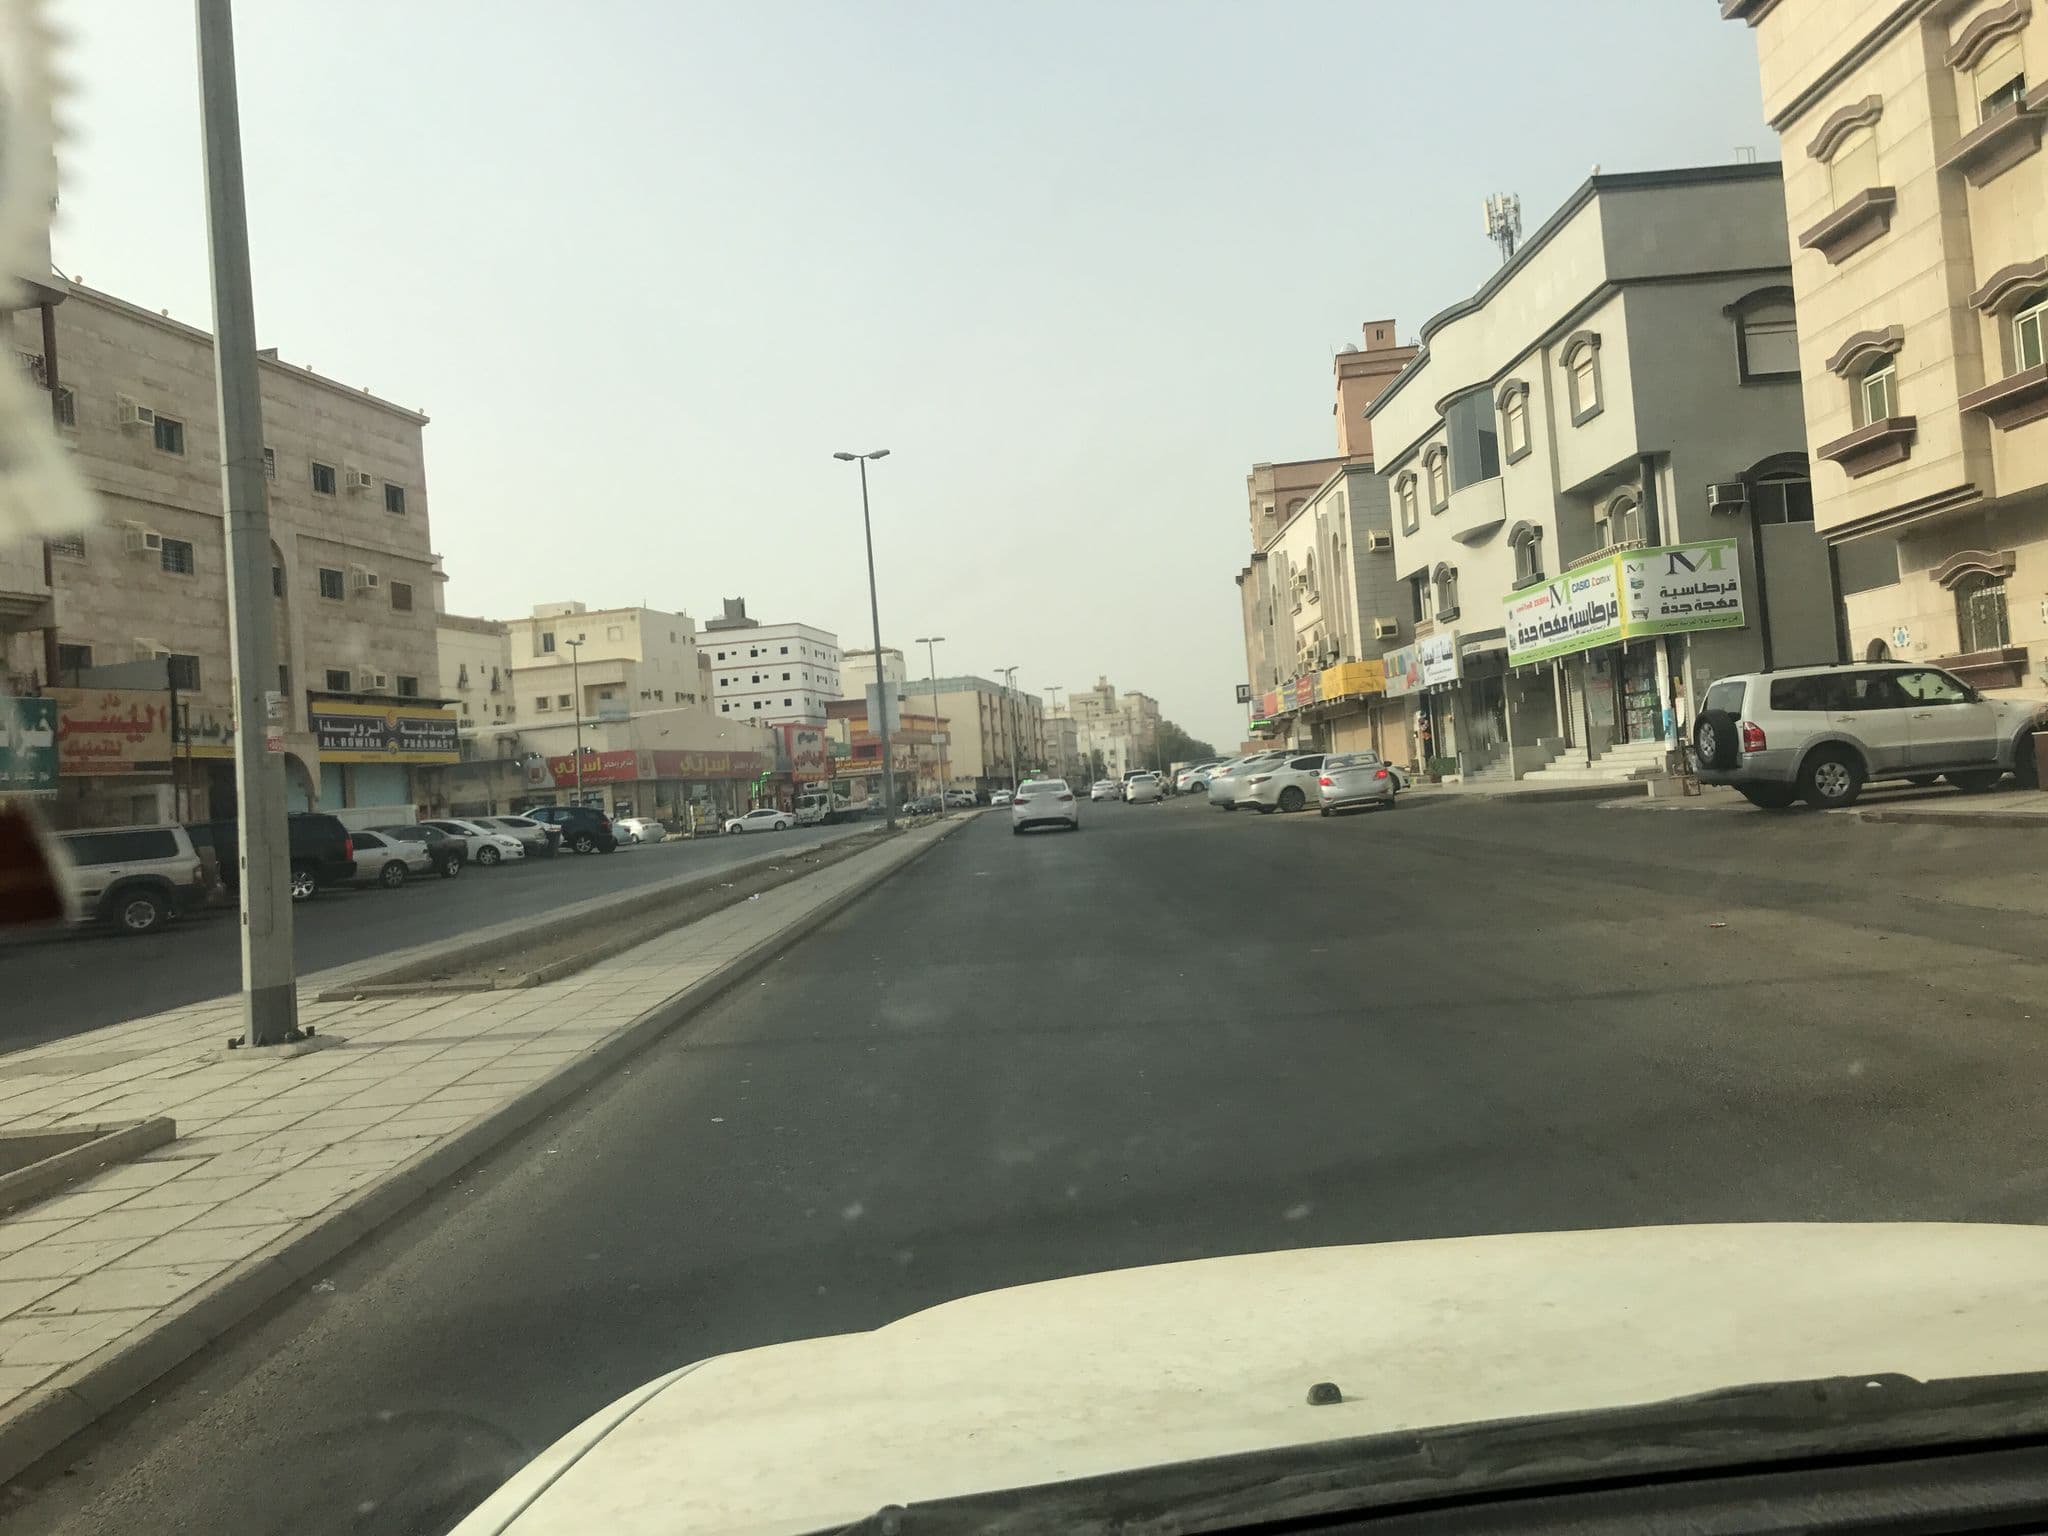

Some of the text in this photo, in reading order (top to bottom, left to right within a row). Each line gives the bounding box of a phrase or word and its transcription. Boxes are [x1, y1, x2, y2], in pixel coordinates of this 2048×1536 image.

[1571, 579, 1591, 593] CASIO
[1660, 579, 1737, 600] قرطاسية
[401, 721, 456, 738] صيدلية
